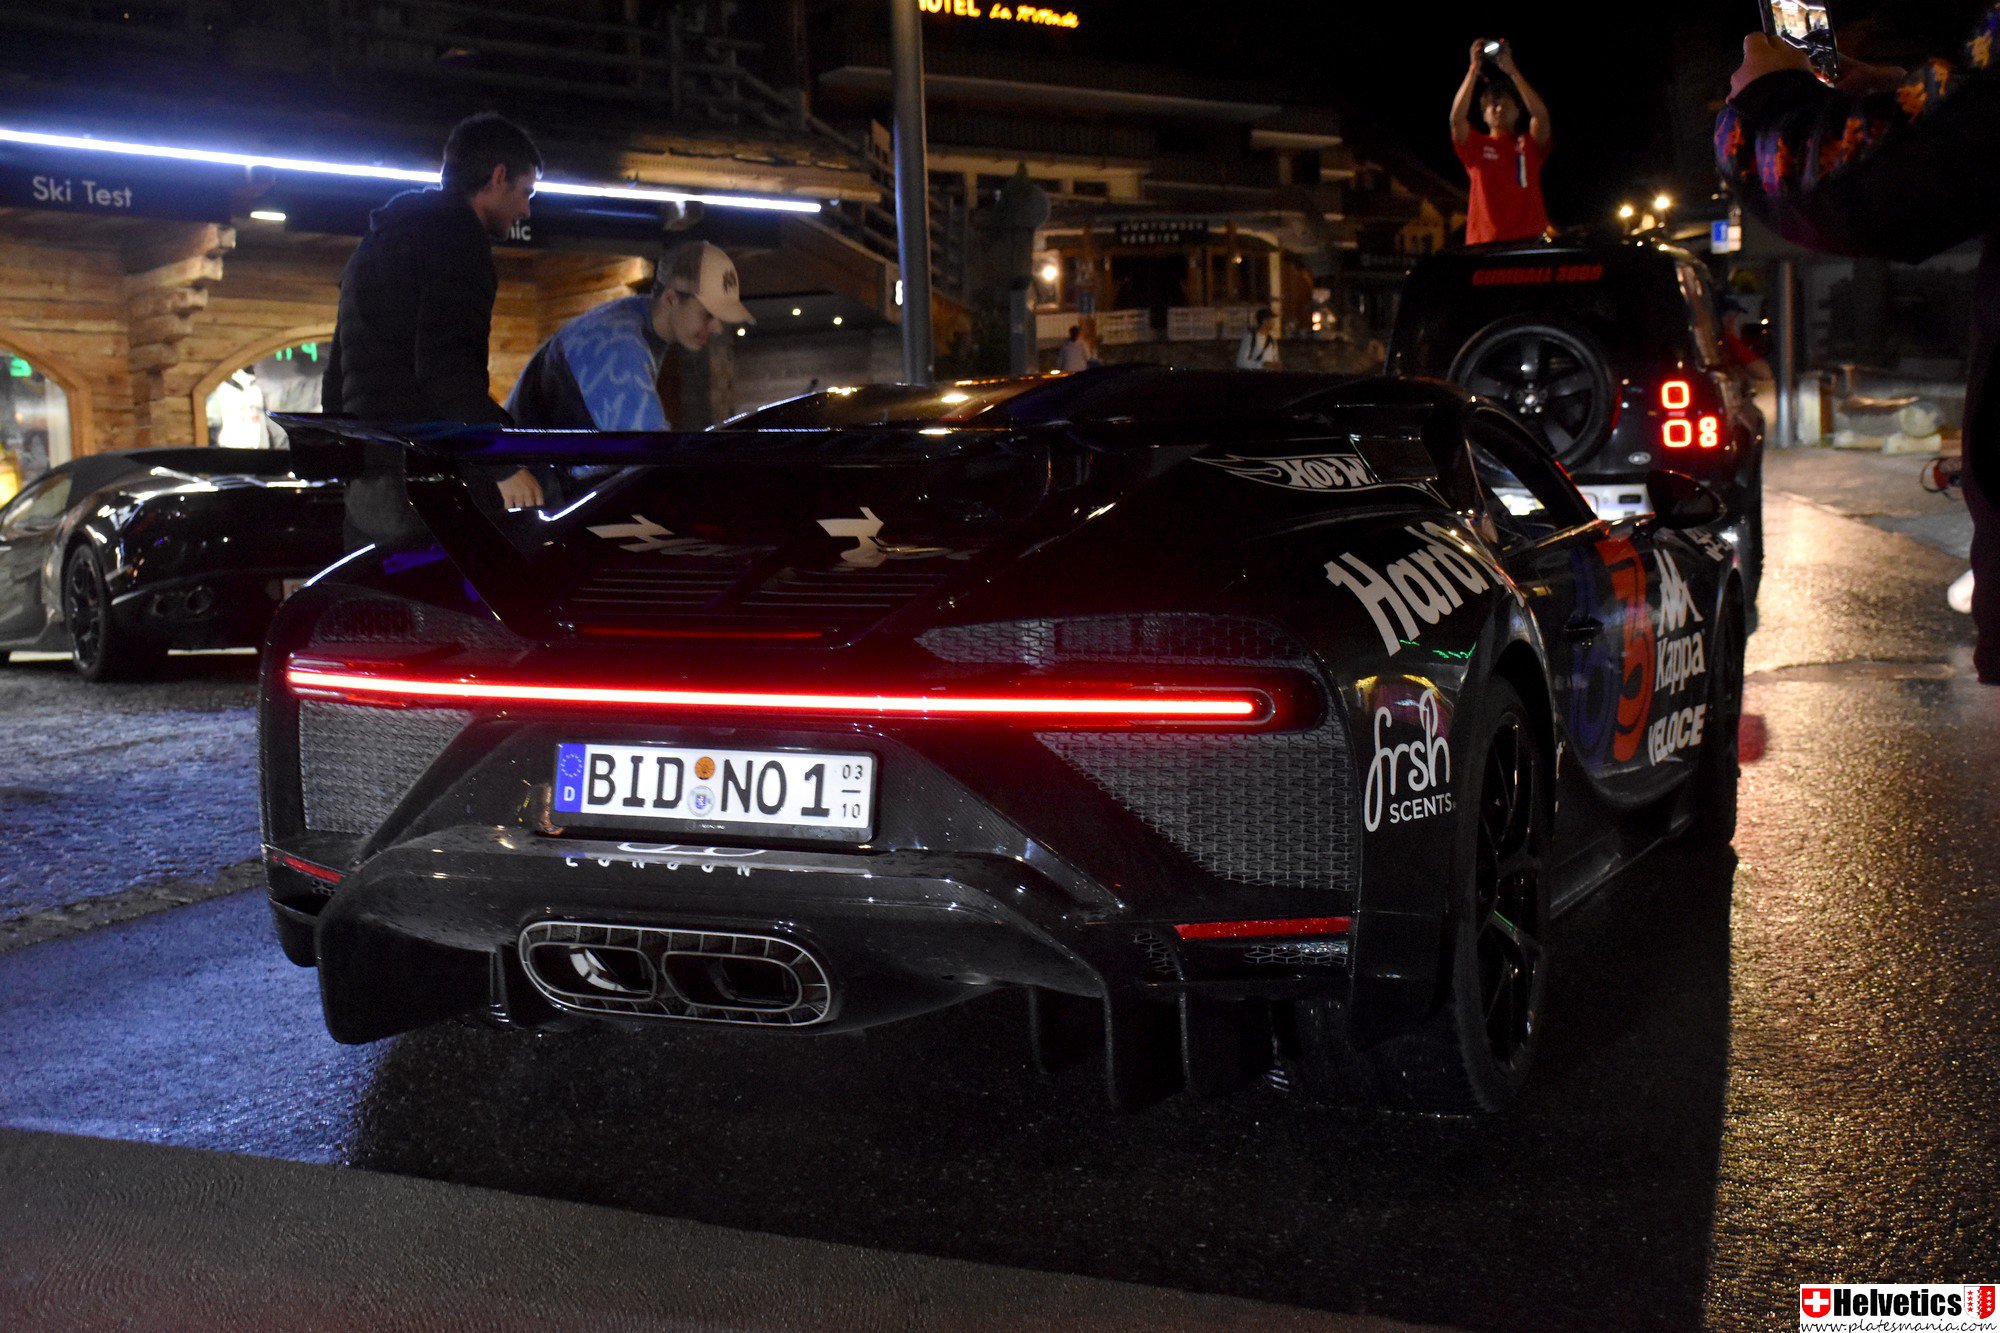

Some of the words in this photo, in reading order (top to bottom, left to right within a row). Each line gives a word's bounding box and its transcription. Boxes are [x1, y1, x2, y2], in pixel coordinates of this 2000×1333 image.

[32, 175, 72, 202] Ski
[82, 180, 133, 208] Test
[1654, 631, 1707, 696] Kappa
[1648, 703, 1707, 767] VELOCE
[842, 764, 864, 780] 03
[1363, 688, 1451, 833] frsh
[563, 785, 576, 802] D
[587, 753, 685, 810] BID
[720, 758, 788, 816] NO
[800, 763, 831, 818] 1
[842, 803, 861, 819] 10
[1388, 792, 1453, 824] SCENTS
